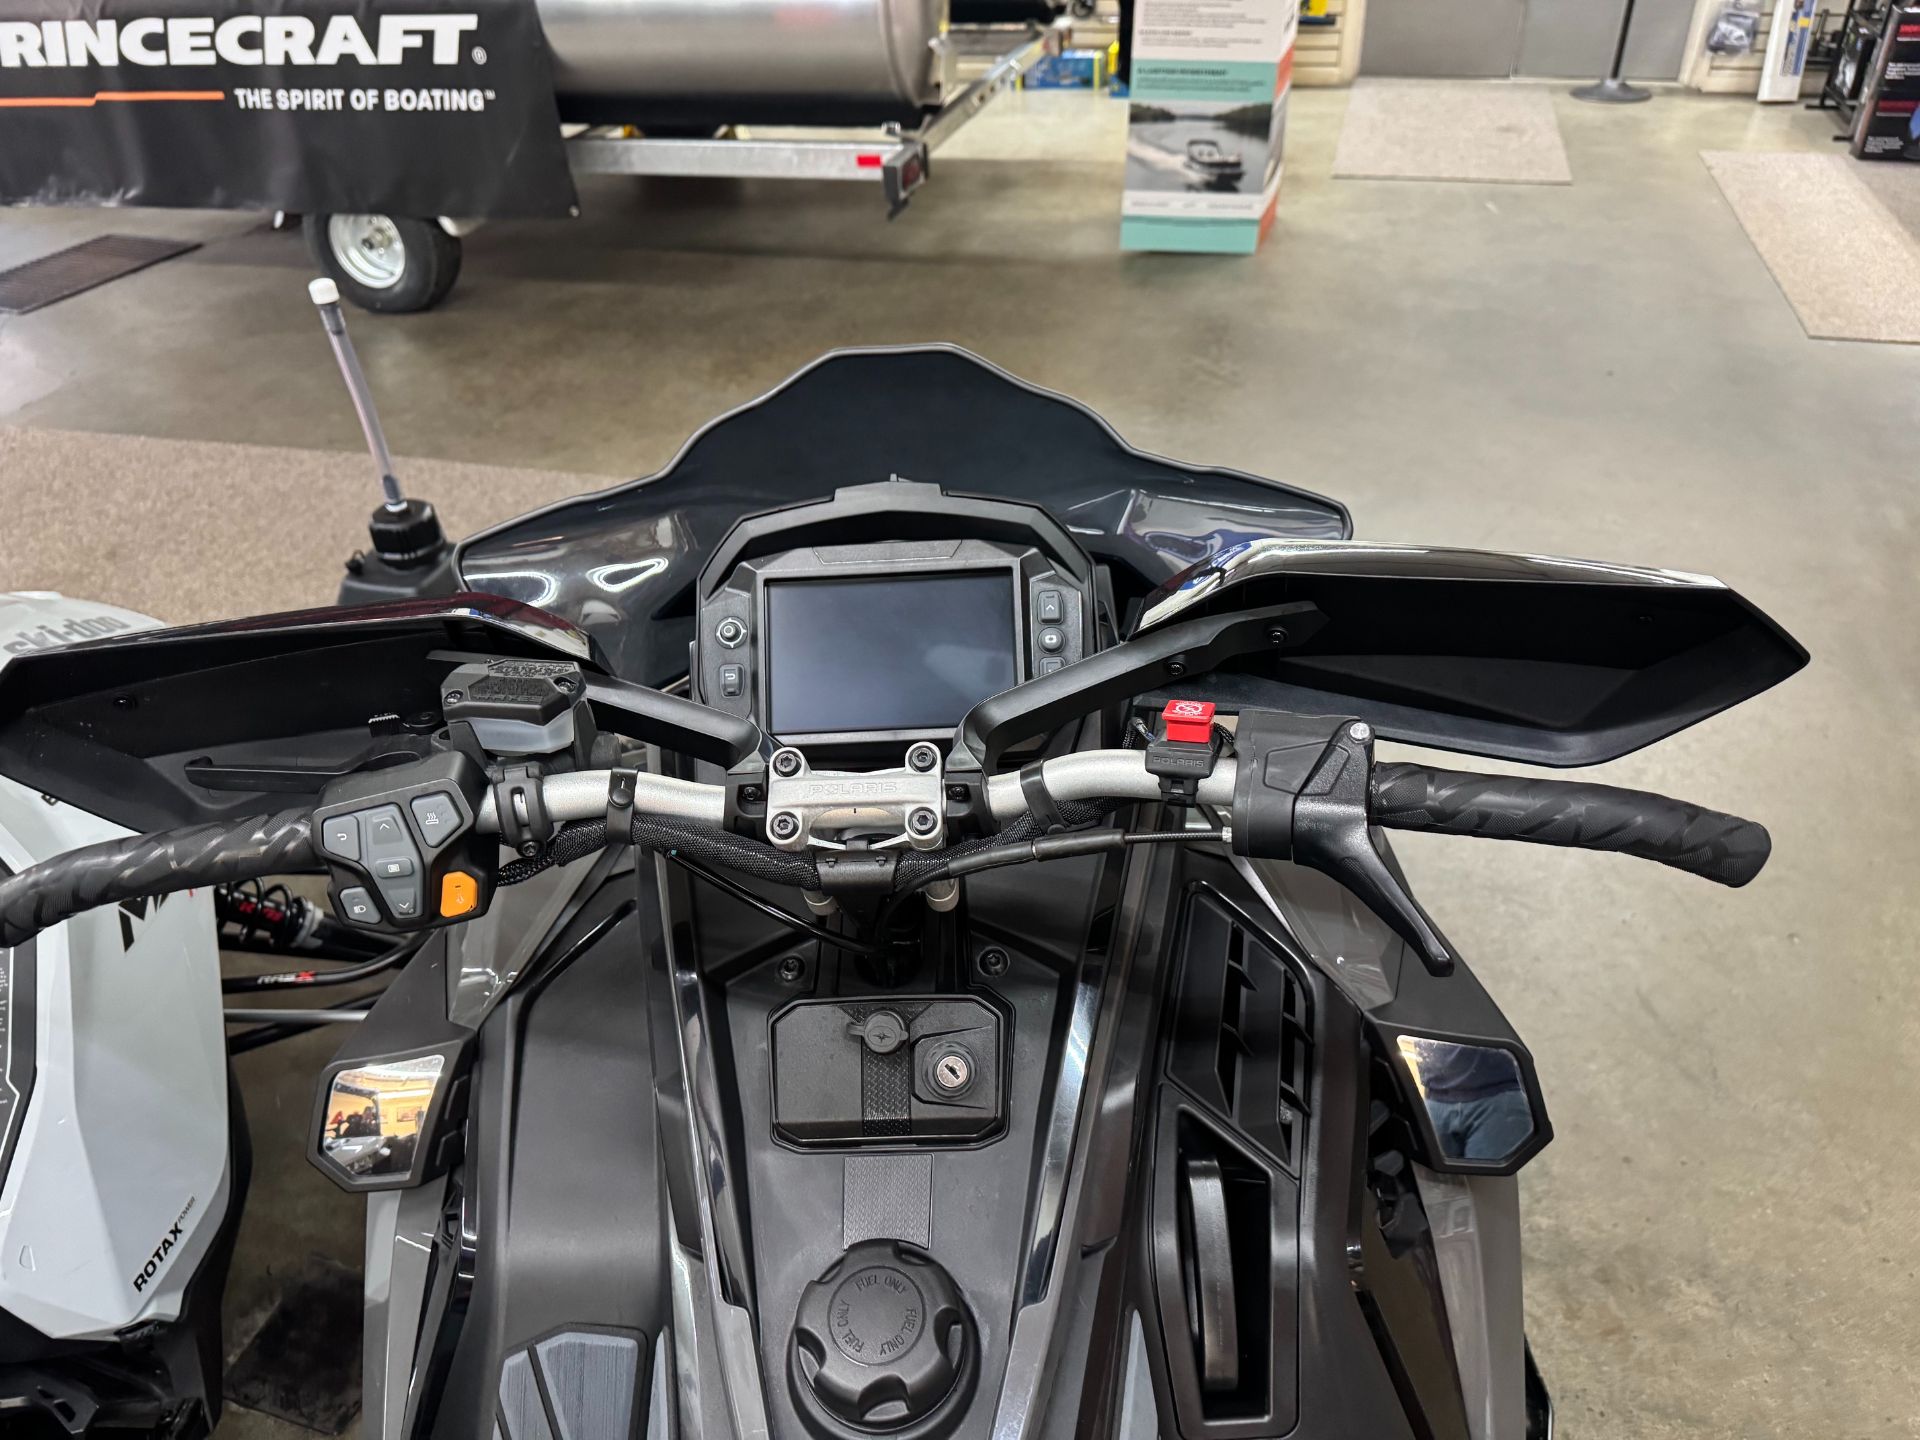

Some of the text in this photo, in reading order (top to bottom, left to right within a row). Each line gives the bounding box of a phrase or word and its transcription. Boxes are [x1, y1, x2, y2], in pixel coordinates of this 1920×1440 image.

[233, 88, 273, 109] THE
[276, 88, 345, 110] SPIRIT
[349, 89, 379, 111] OF
[1153, 755, 1205, 768] POLARIS
[808, 781, 898, 795] POLARIS
[133, 1221, 183, 1293] ROTAX
[855, 1274, 907, 1295] FUEL ONLY
[836, 1299, 865, 1353] FUEL ONLY
[880, 1308, 918, 1356] FUEL ONLY
